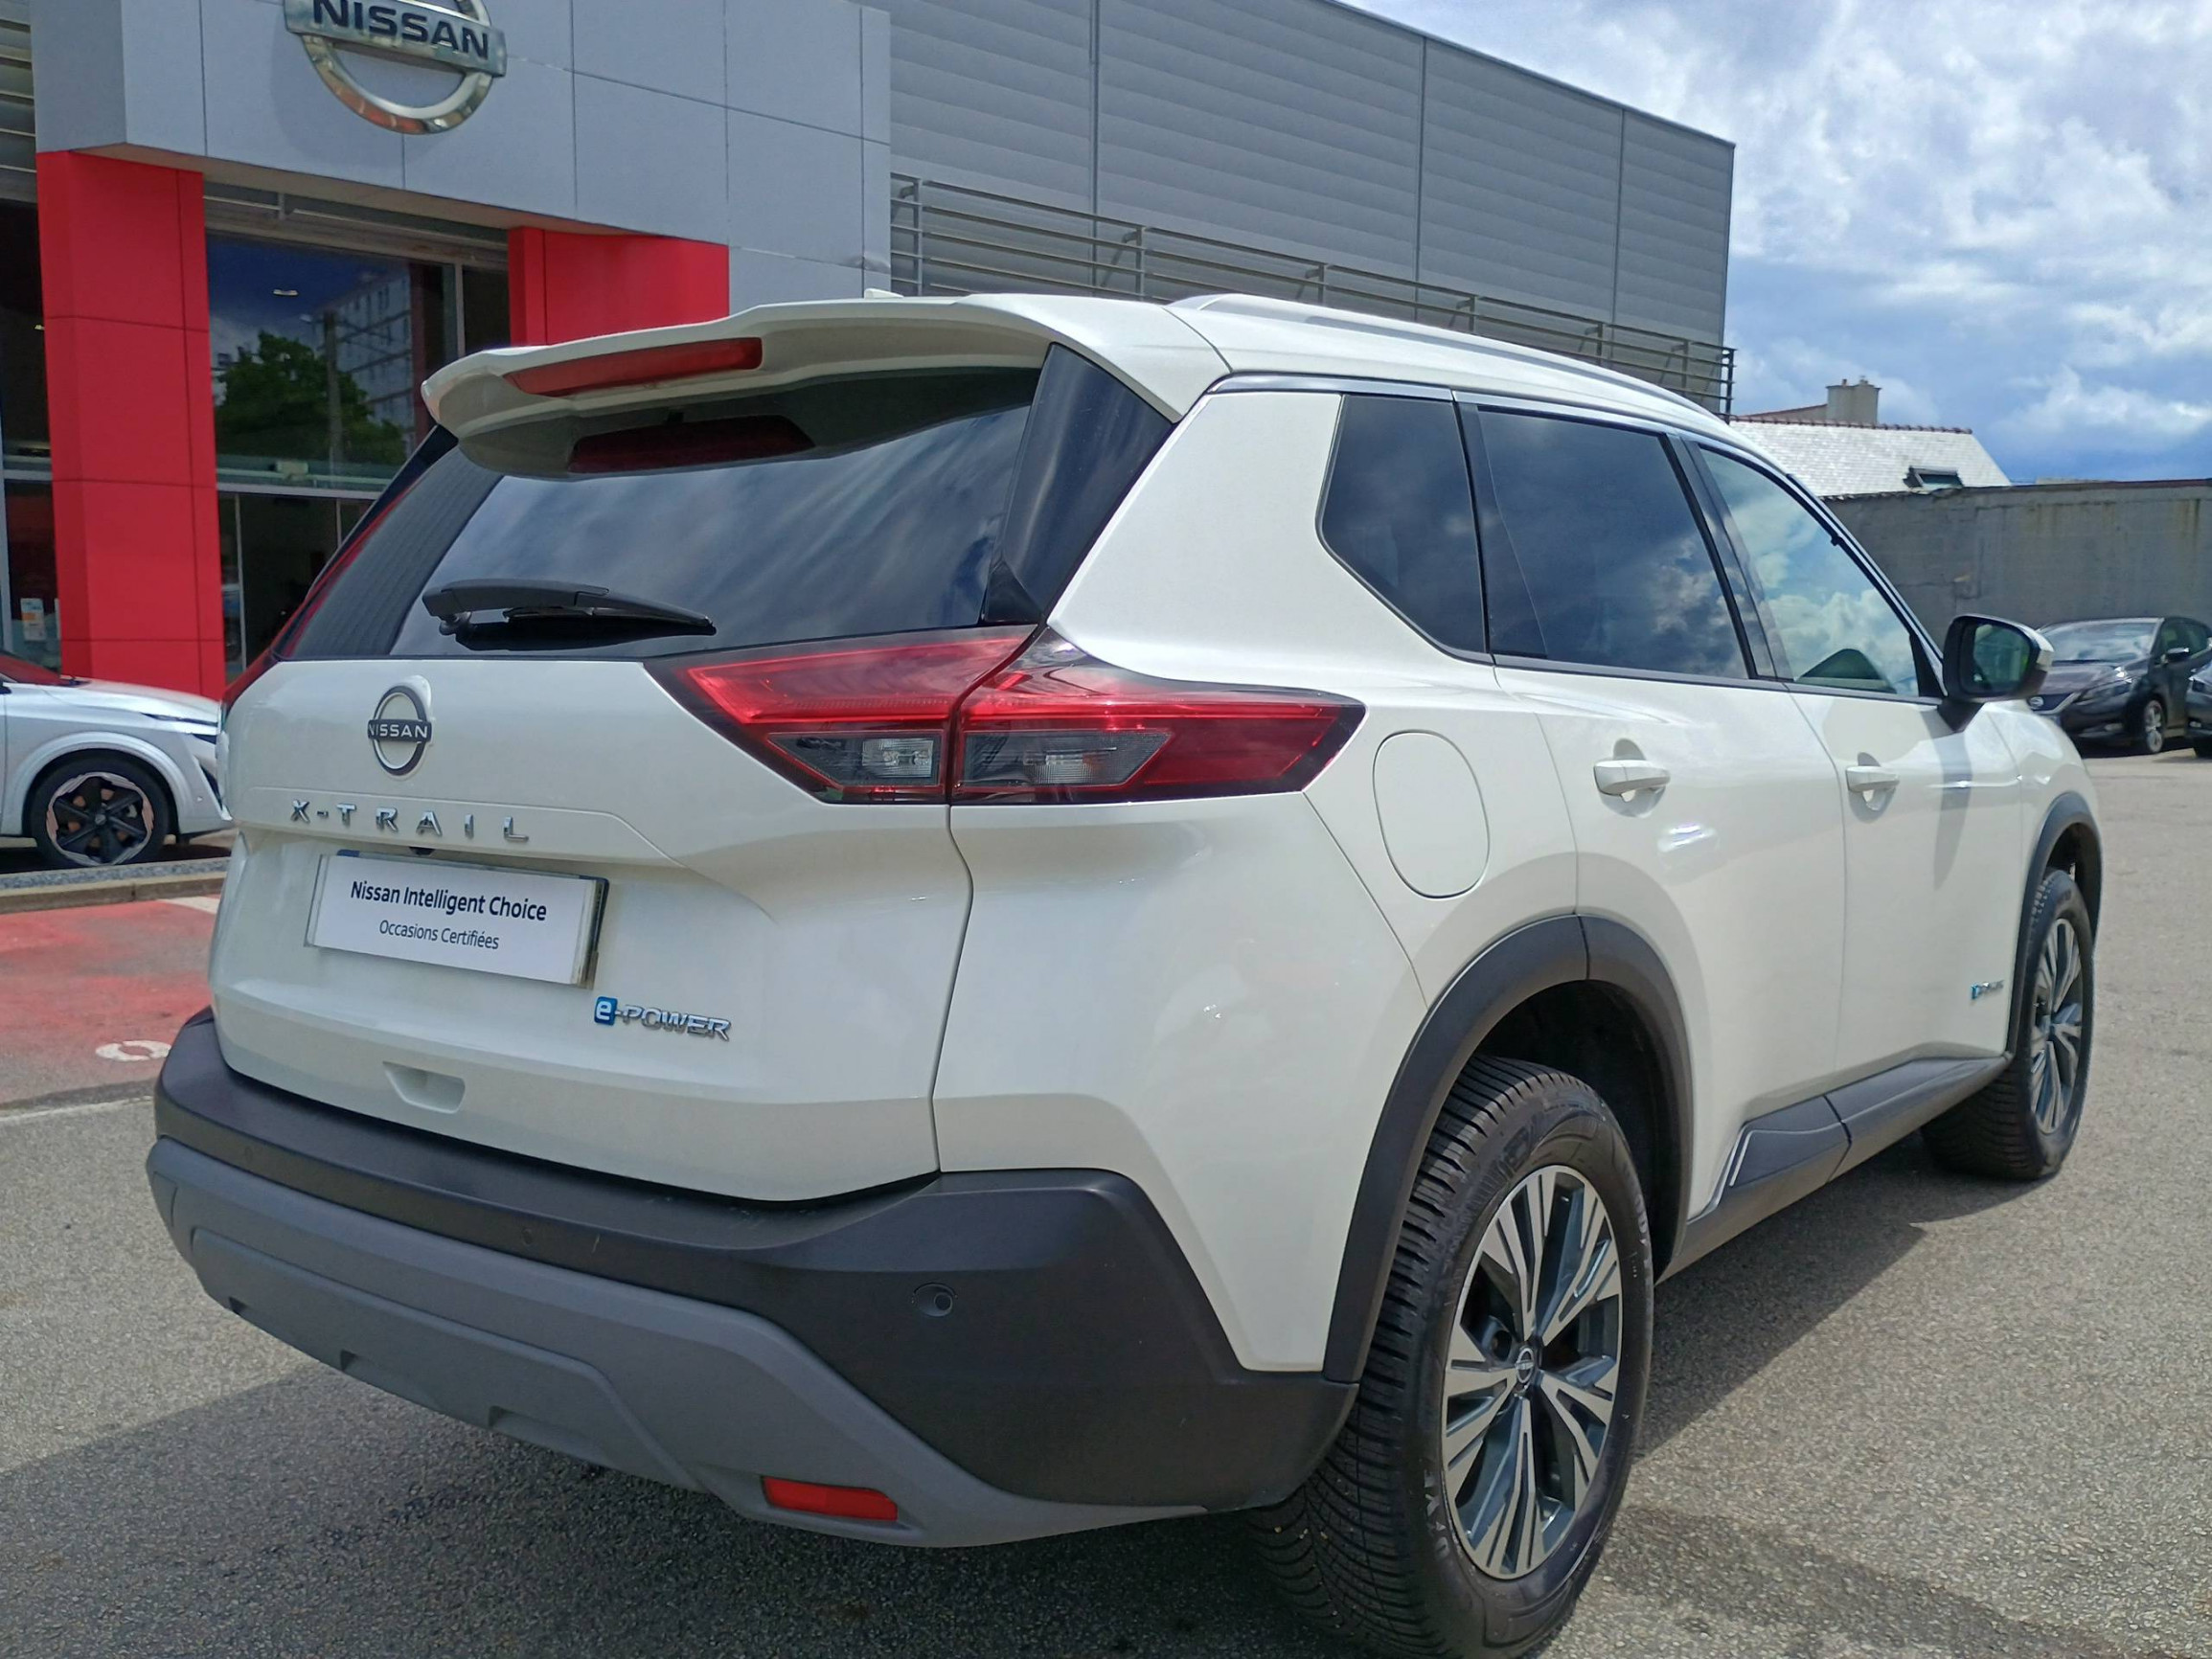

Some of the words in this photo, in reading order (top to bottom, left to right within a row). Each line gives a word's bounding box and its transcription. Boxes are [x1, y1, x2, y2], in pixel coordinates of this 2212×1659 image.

[313, 0, 489, 59] NISSAN
[369, 723, 428, 739] NISSAN
[290, 800, 529, 841] X-TRAIL
[351, 880, 400, 904] Nissan
[403, 887, 486, 916] Intelligent
[489, 897, 547, 921] Choice
[379, 920, 439, 942] Occasions
[441, 927, 499, 950] Certifiées
[594, 996, 732, 1041] e-POWER
